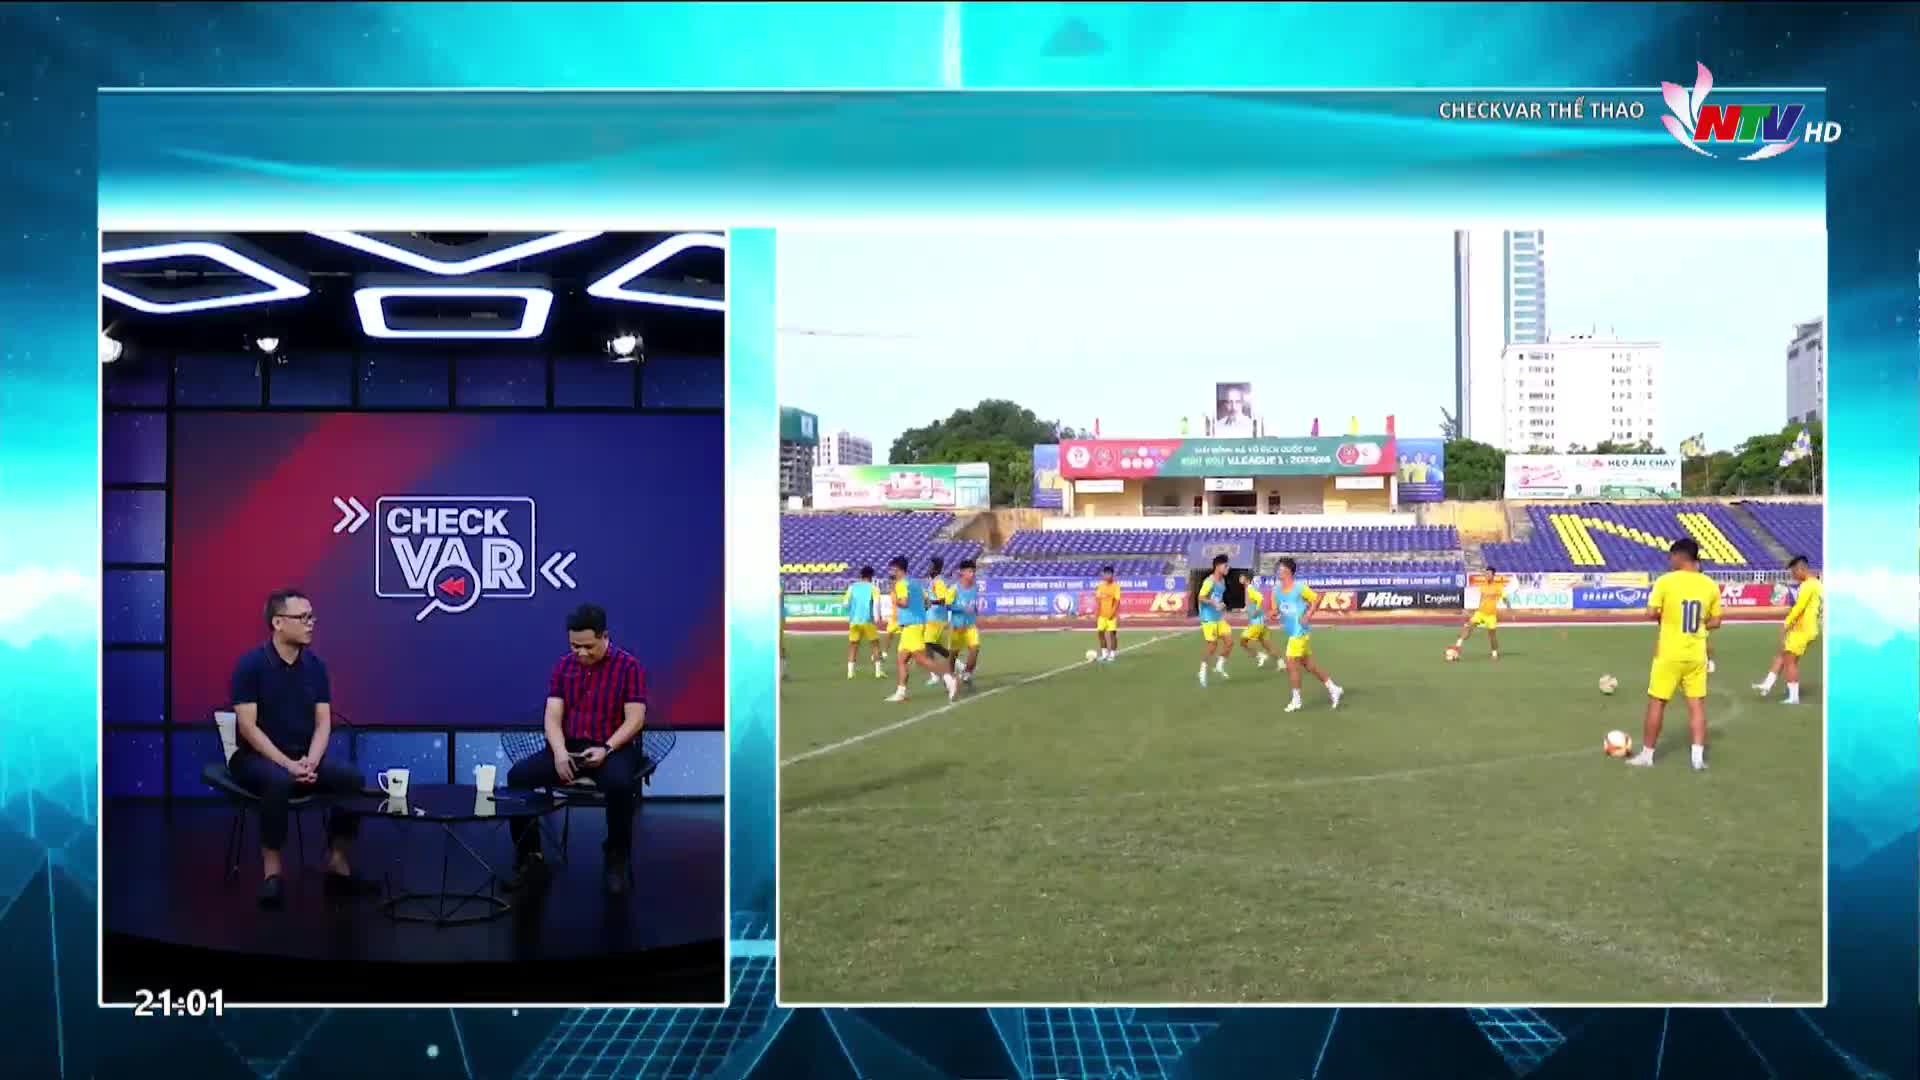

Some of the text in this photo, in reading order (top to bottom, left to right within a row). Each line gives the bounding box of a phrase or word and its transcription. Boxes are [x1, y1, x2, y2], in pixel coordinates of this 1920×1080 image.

[1649, 459, 1676, 467] CHAY
[386, 507, 509, 535] CHECK
[390, 537, 526, 589] VAR
[1361, 592, 1460, 609] Mitre England
[1681, 599, 1701, 634] 10
